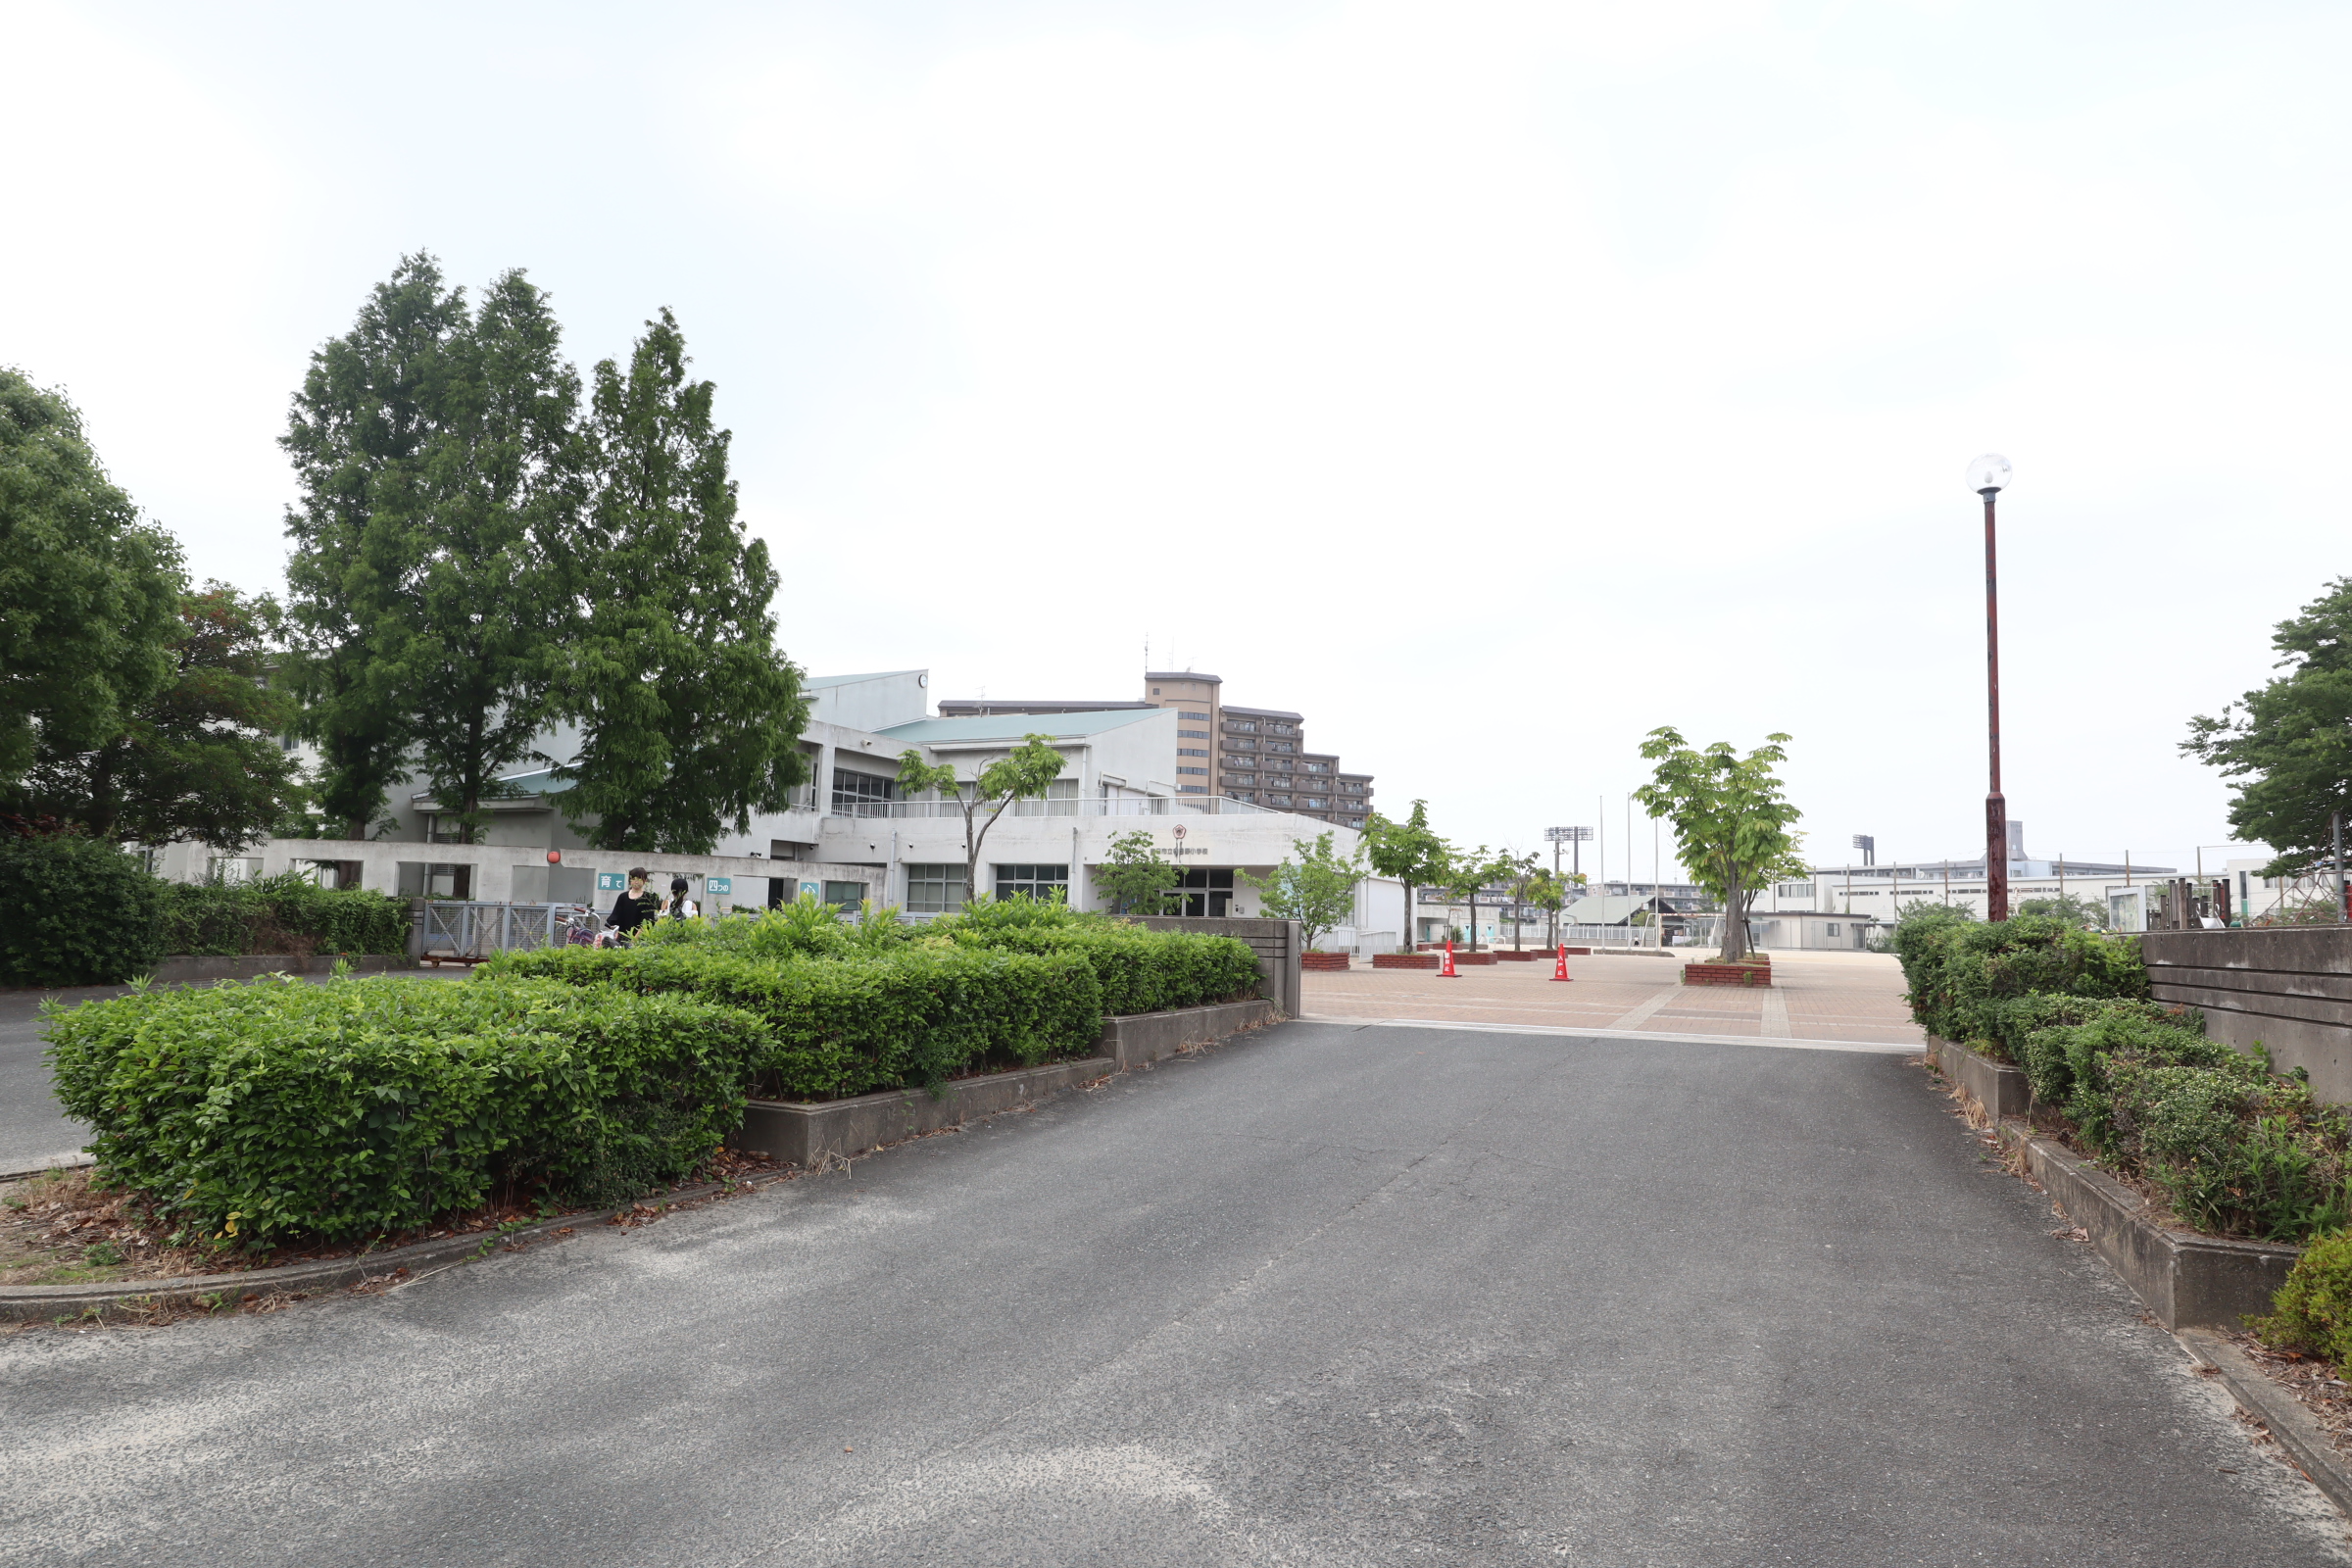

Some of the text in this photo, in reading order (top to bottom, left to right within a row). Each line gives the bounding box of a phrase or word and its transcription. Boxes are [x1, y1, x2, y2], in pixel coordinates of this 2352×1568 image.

[601, 875, 623, 888] 育て
[709, 879, 729, 892] 四つの
